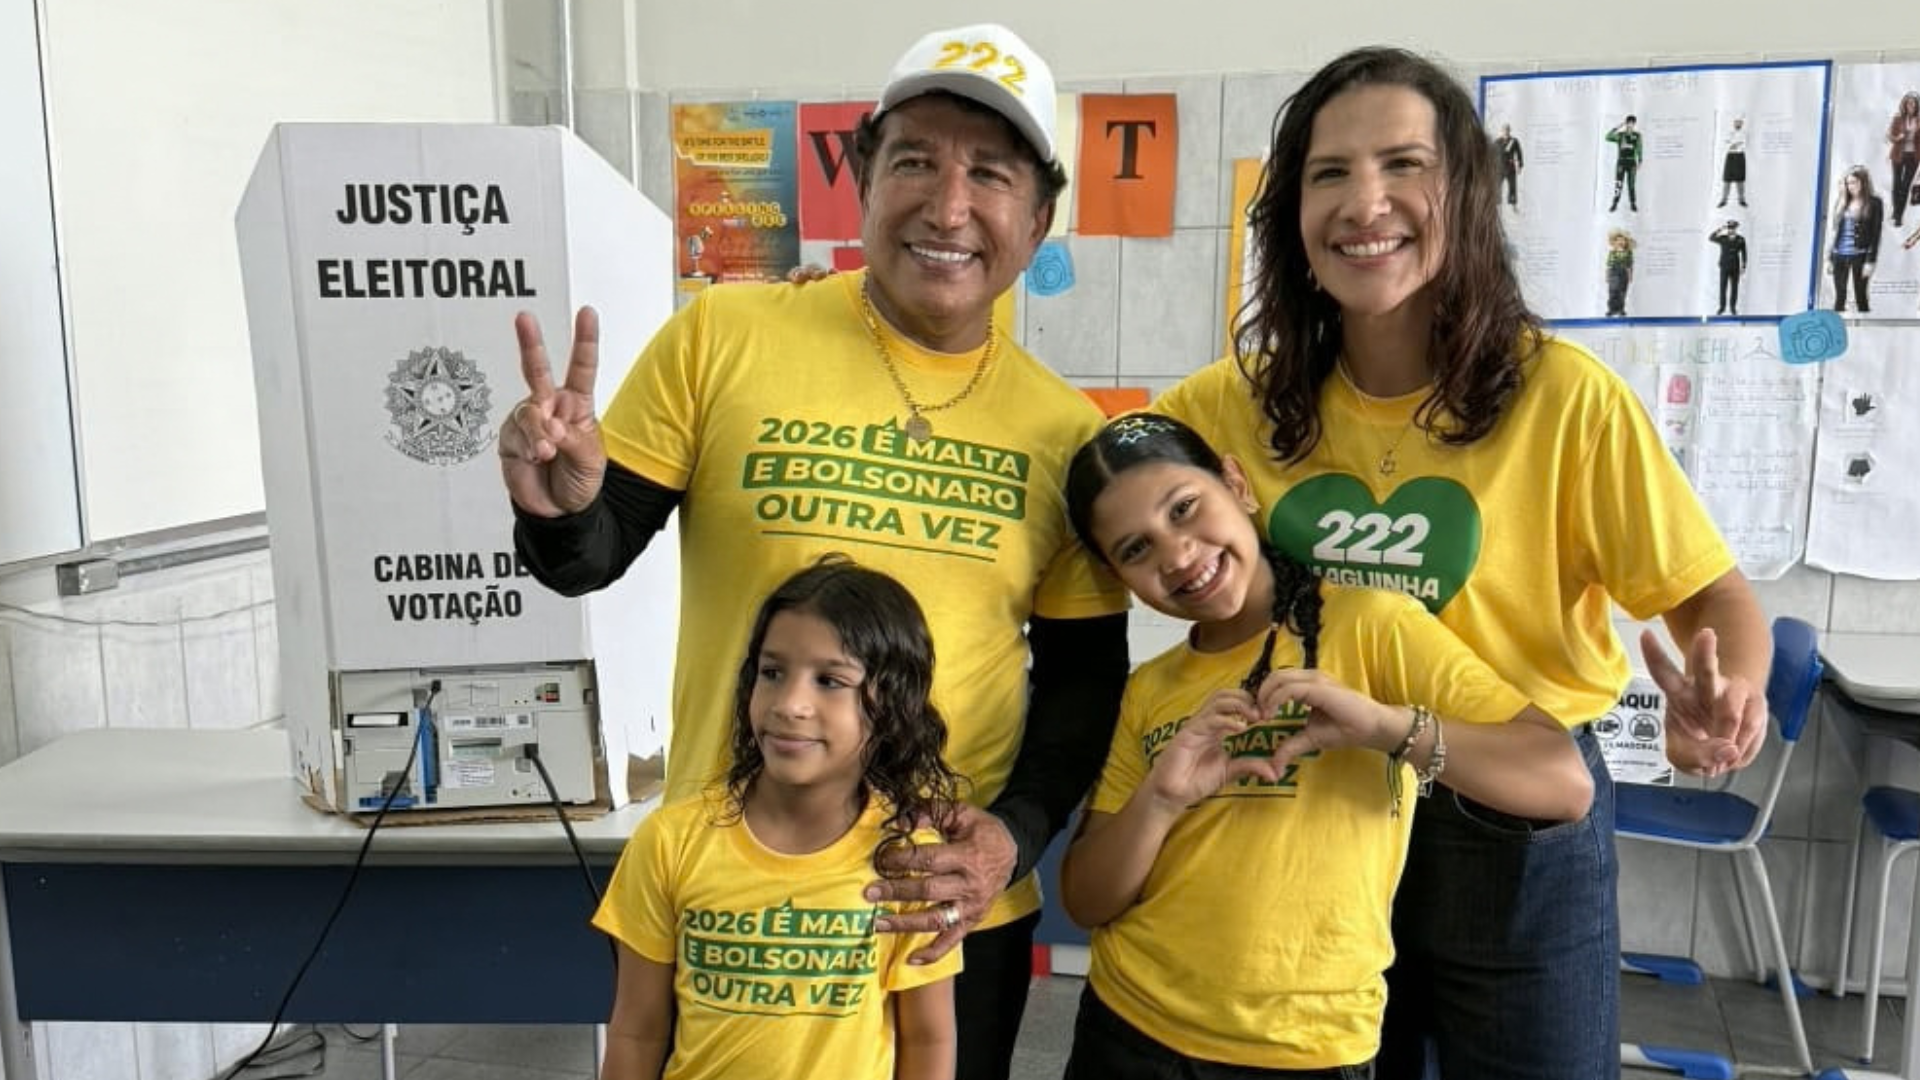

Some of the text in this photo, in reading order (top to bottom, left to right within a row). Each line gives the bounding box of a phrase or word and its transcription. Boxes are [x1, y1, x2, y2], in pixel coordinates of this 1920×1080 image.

[935, 41, 1026, 96] 222
[1106, 120, 1156, 179] T
[336, 183, 510, 235] JUSTIÇA
[317, 258, 537, 298] ELEITORAL
[758, 417, 1021, 478] 2026 É MALTA
[752, 456, 1017, 511] E BOLSONARO
[757, 494, 1004, 550] OUTRA VEZ
[1313, 509, 1431, 567] 222
[374, 552, 484, 583] CABINA
[1312, 565, 1440, 600] AGUINHA
[388, 585, 522, 625] VOTAÇÃO
[684, 908, 757, 935] 2026
[772, 907, 791, 933] É
[687, 939, 699, 962] E
[693, 972, 867, 1007] OUTRA VEZ
